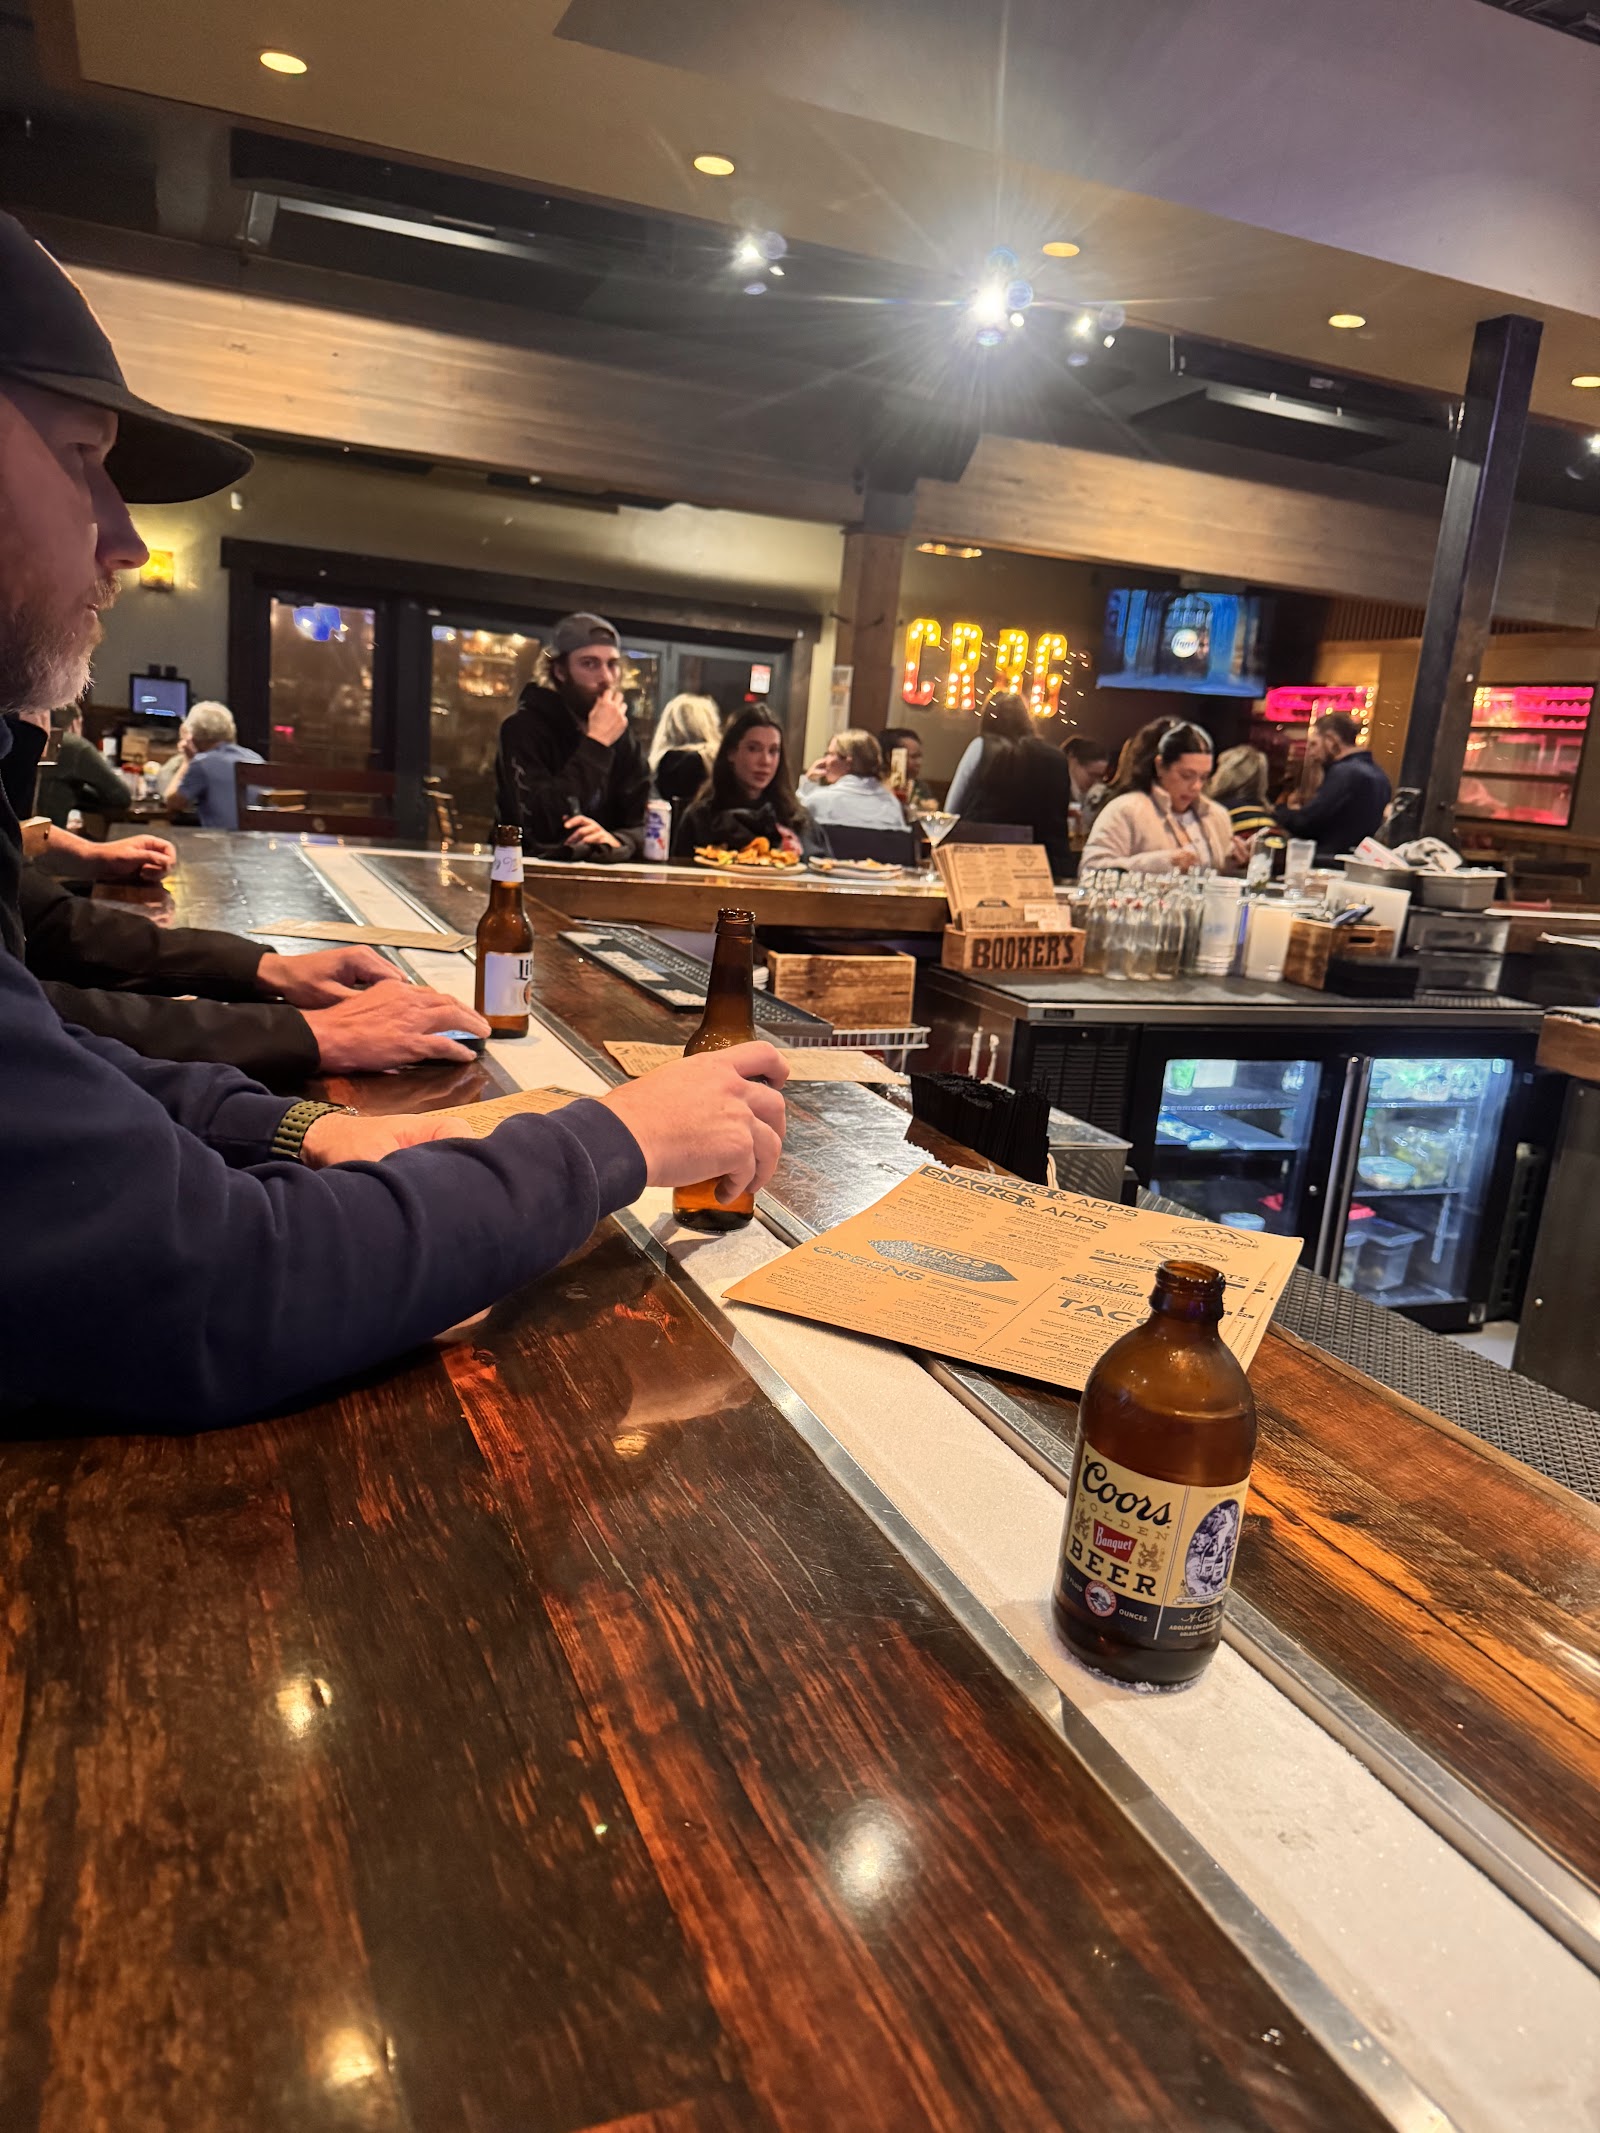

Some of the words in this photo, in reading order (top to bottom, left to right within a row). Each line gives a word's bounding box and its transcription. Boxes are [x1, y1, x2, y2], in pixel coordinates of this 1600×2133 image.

[971, 934, 1075, 968] BOOKER'S
[925, 1168, 1019, 1205] SNACKS
[1021, 1197, 1036, 1208] &
[1041, 1205, 1109, 1230] APPS
[953, 1168, 1050, 1198] SNACKS
[1053, 1190, 1067, 1202] &
[1073, 1197, 1139, 1218] APPS
[911, 1245, 987, 1268] WINGS
[1094, 1248, 1155, 1263] SAUCE
[1139, 1242, 1189, 1255] CRAGGY
[1188, 1252, 1230, 1263] RANGE
[1219, 1238, 1259, 1249] RANGE
[813, 1245, 927, 1281] GREENS
[1074, 1274, 1140, 1291] SOUP
[1082, 1455, 1172, 1526] Coors
[1079, 1492, 1169, 1540] GOLDEN
[1095, 1526, 1133, 1553] Banquet
[1070, 1534, 1156, 1596] BEER
[1119, 1608, 1148, 1622] OUNCES
